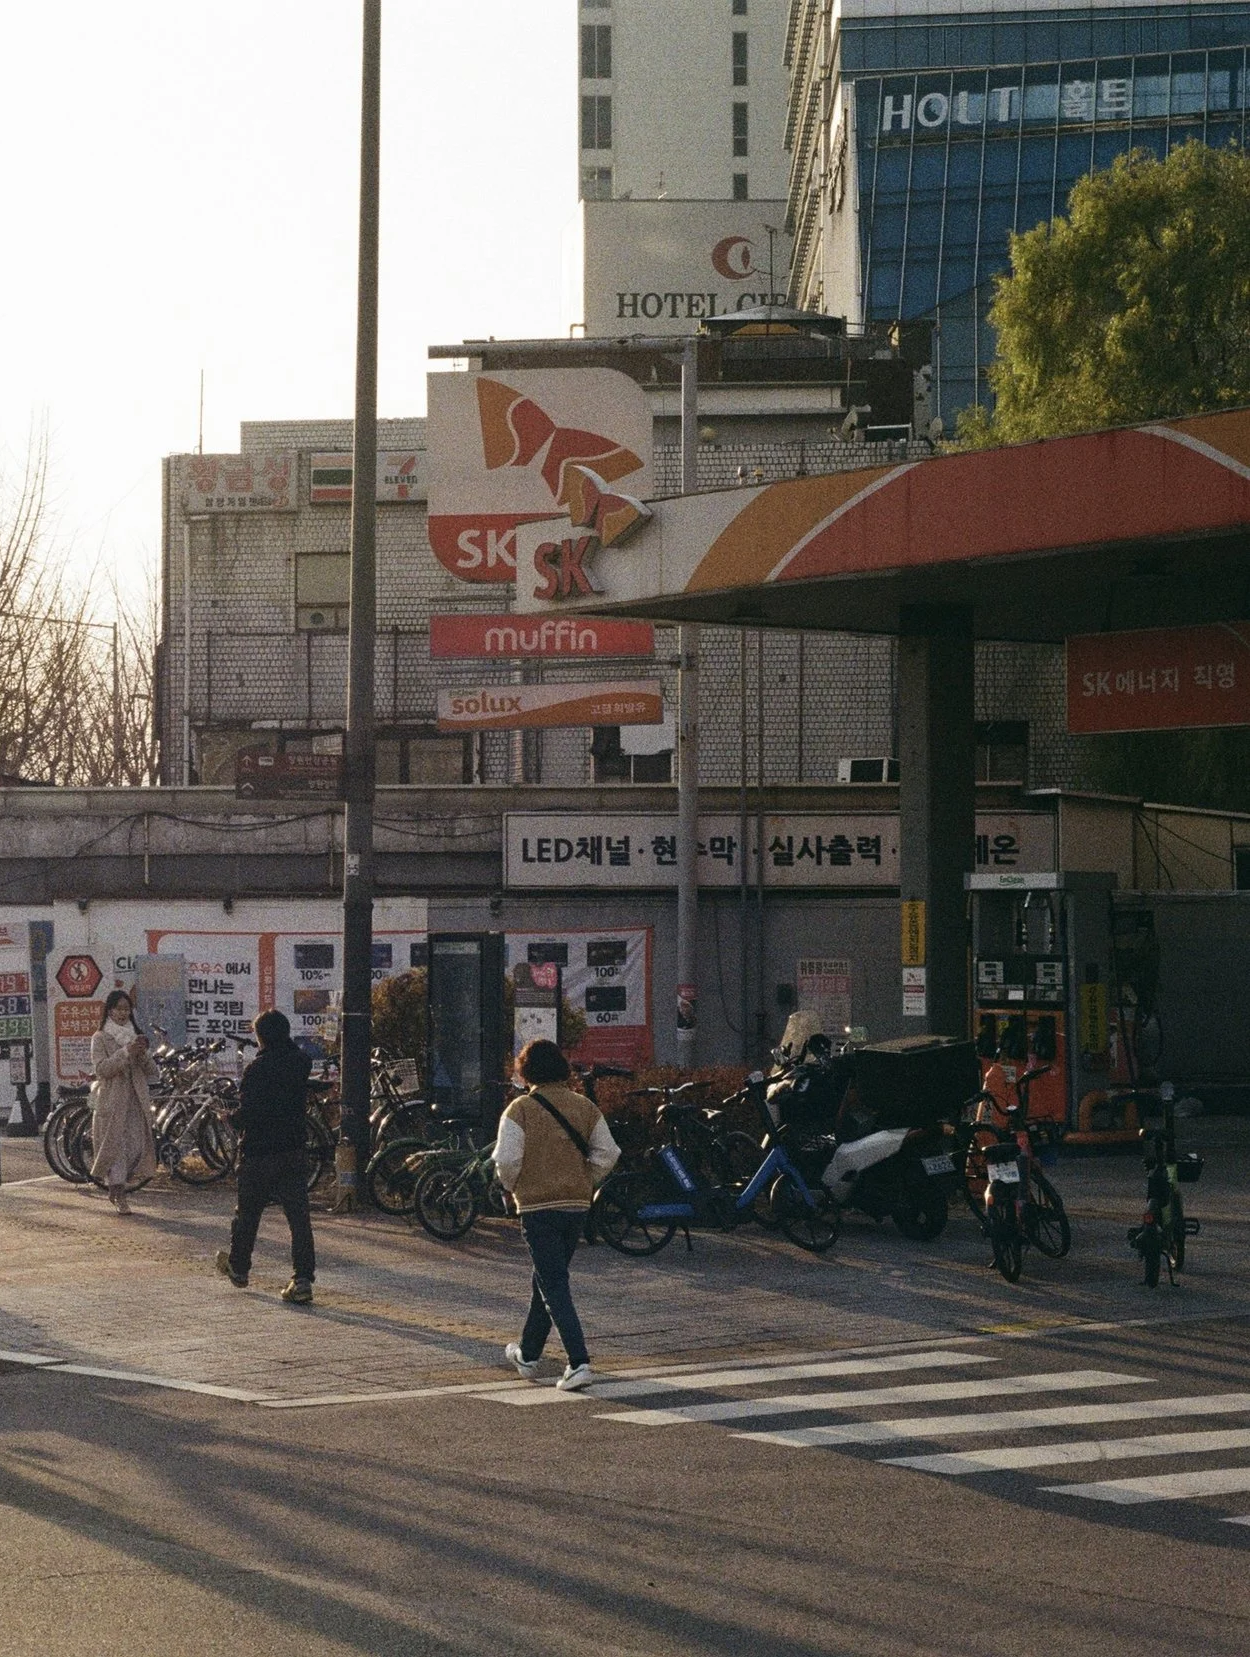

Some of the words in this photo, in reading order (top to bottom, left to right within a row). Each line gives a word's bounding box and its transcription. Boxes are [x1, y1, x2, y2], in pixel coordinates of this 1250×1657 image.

[882, 86, 1019, 131] HOLT
[1062, 79, 1130, 118] 홀트
[616, 293, 727, 318] HOTEL
[456, 528, 517, 569] SK
[533, 536, 596, 601] SK
[485, 620, 597, 652] muffin
[1081, 667, 1179, 697] SK에너지
[1193, 661, 1236, 691] 직영
[452, 691, 522, 715] solux
[520, 835, 629, 867] LED채널
[768, 834, 883, 867] 실사출력
[187, 979, 235, 995] 만나는
[213, 1000, 244, 1016] 적립
